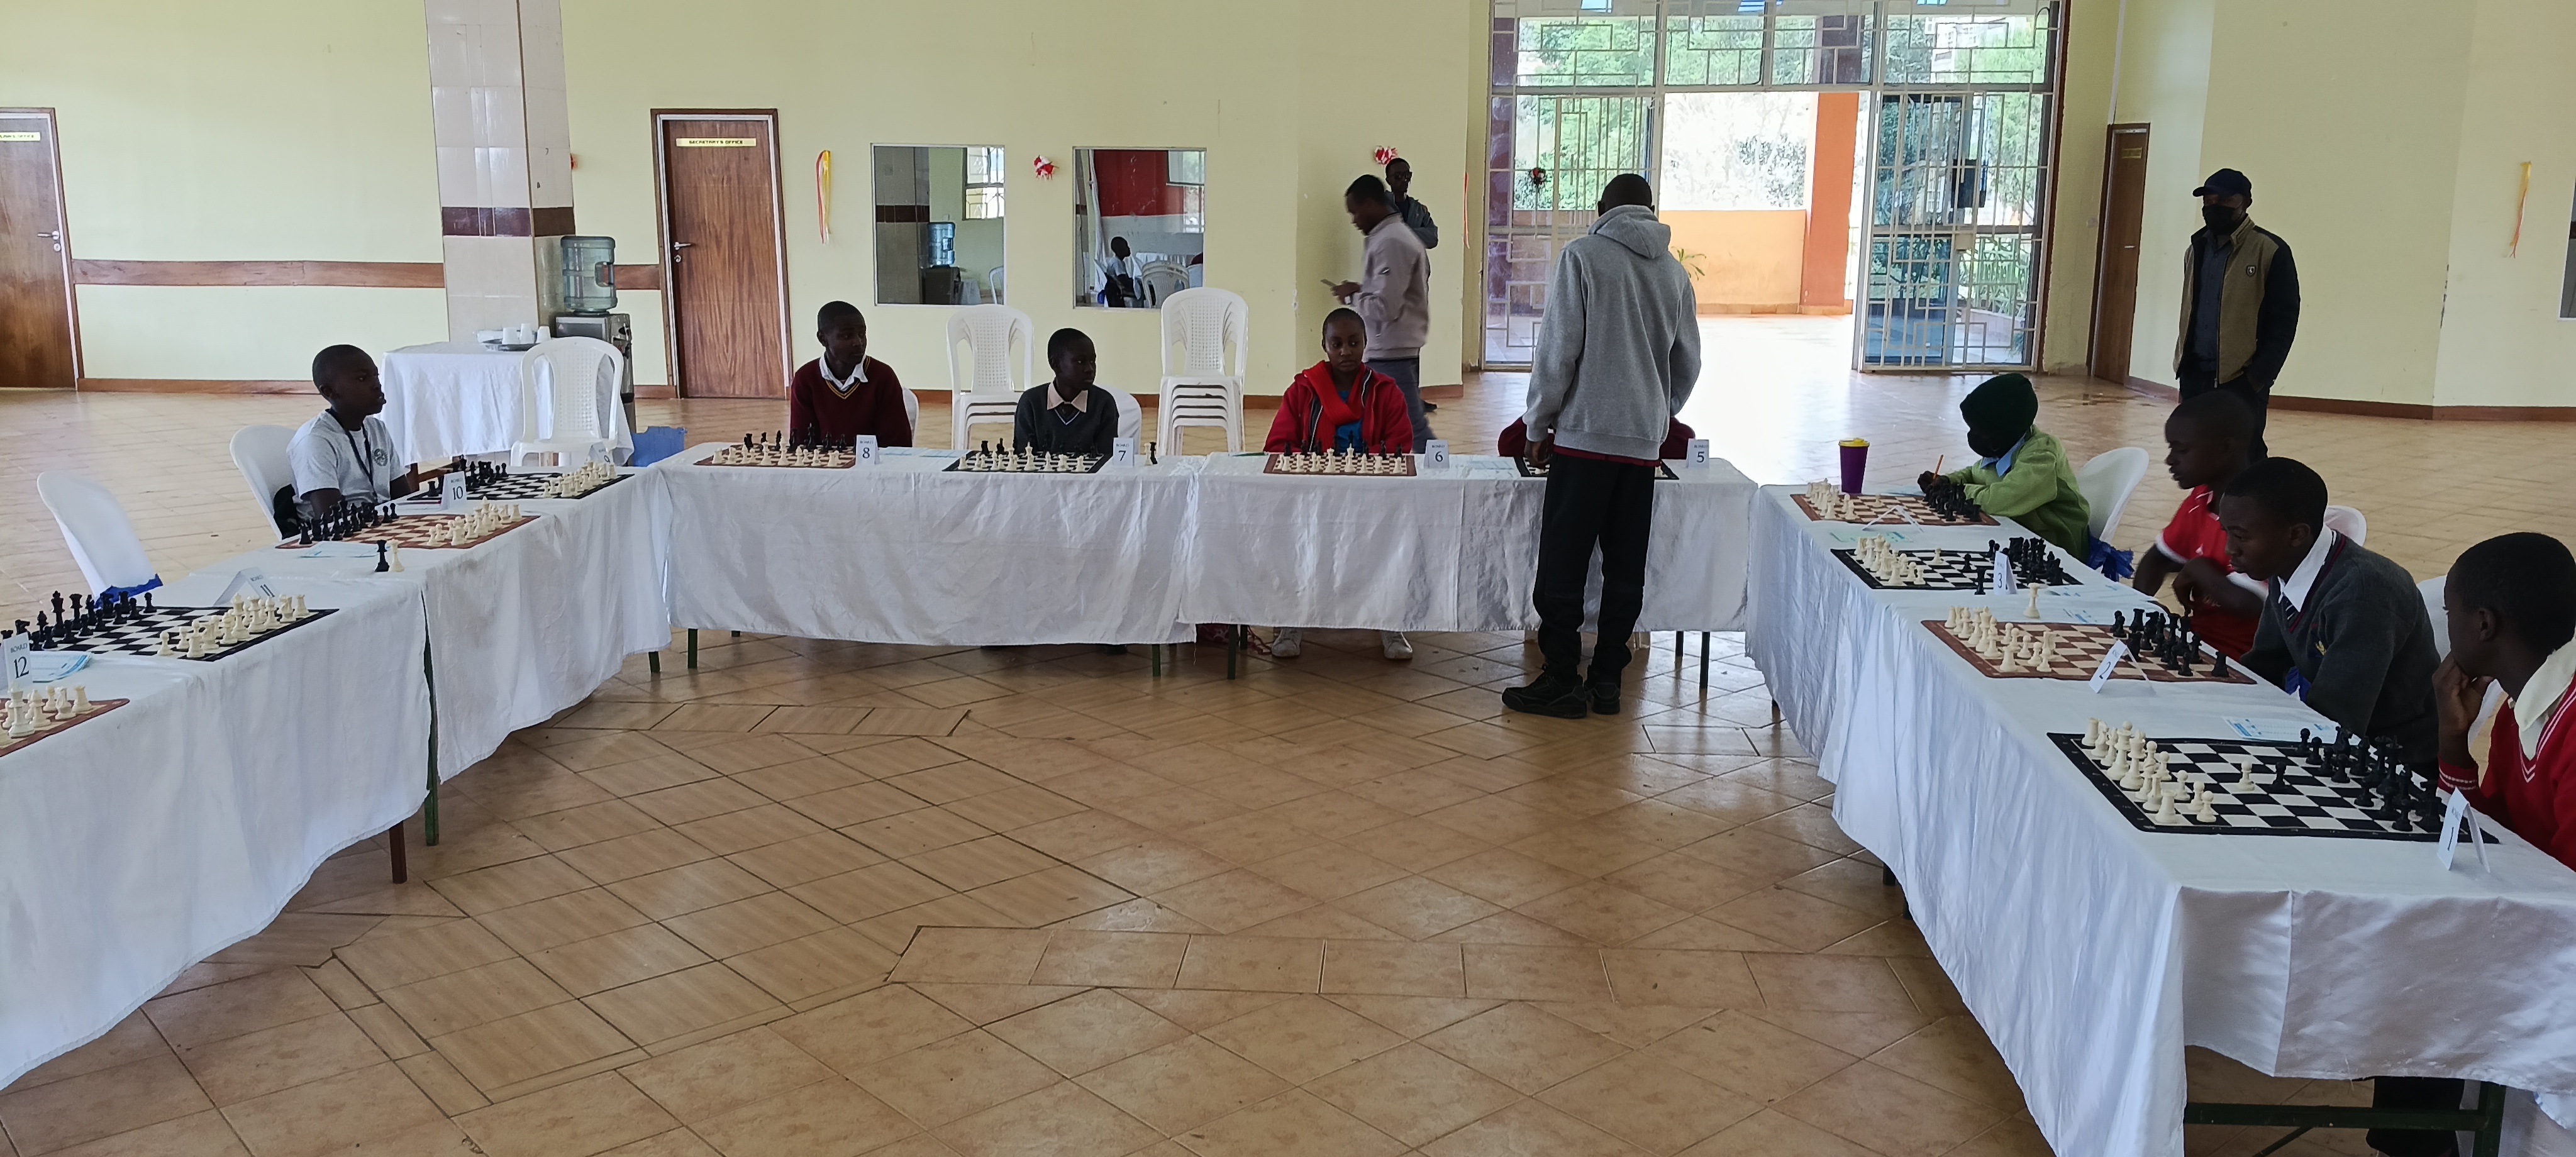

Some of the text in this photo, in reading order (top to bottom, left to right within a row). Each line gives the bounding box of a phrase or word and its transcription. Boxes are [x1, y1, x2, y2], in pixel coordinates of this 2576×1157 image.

[862, 447, 870, 459] 8
[1118, 450, 1126, 462] 7
[1435, 450, 1443, 463] 6
[1696, 451, 1705, 463] 5
[452, 485, 464, 501] 10
[1997, 572, 2003, 589] 3
[260, 584, 275, 597] 11
[13, 656, 30, 679] 12
[2099, 661, 2112, 680] 2
[2447, 826, 2455, 851] 1
